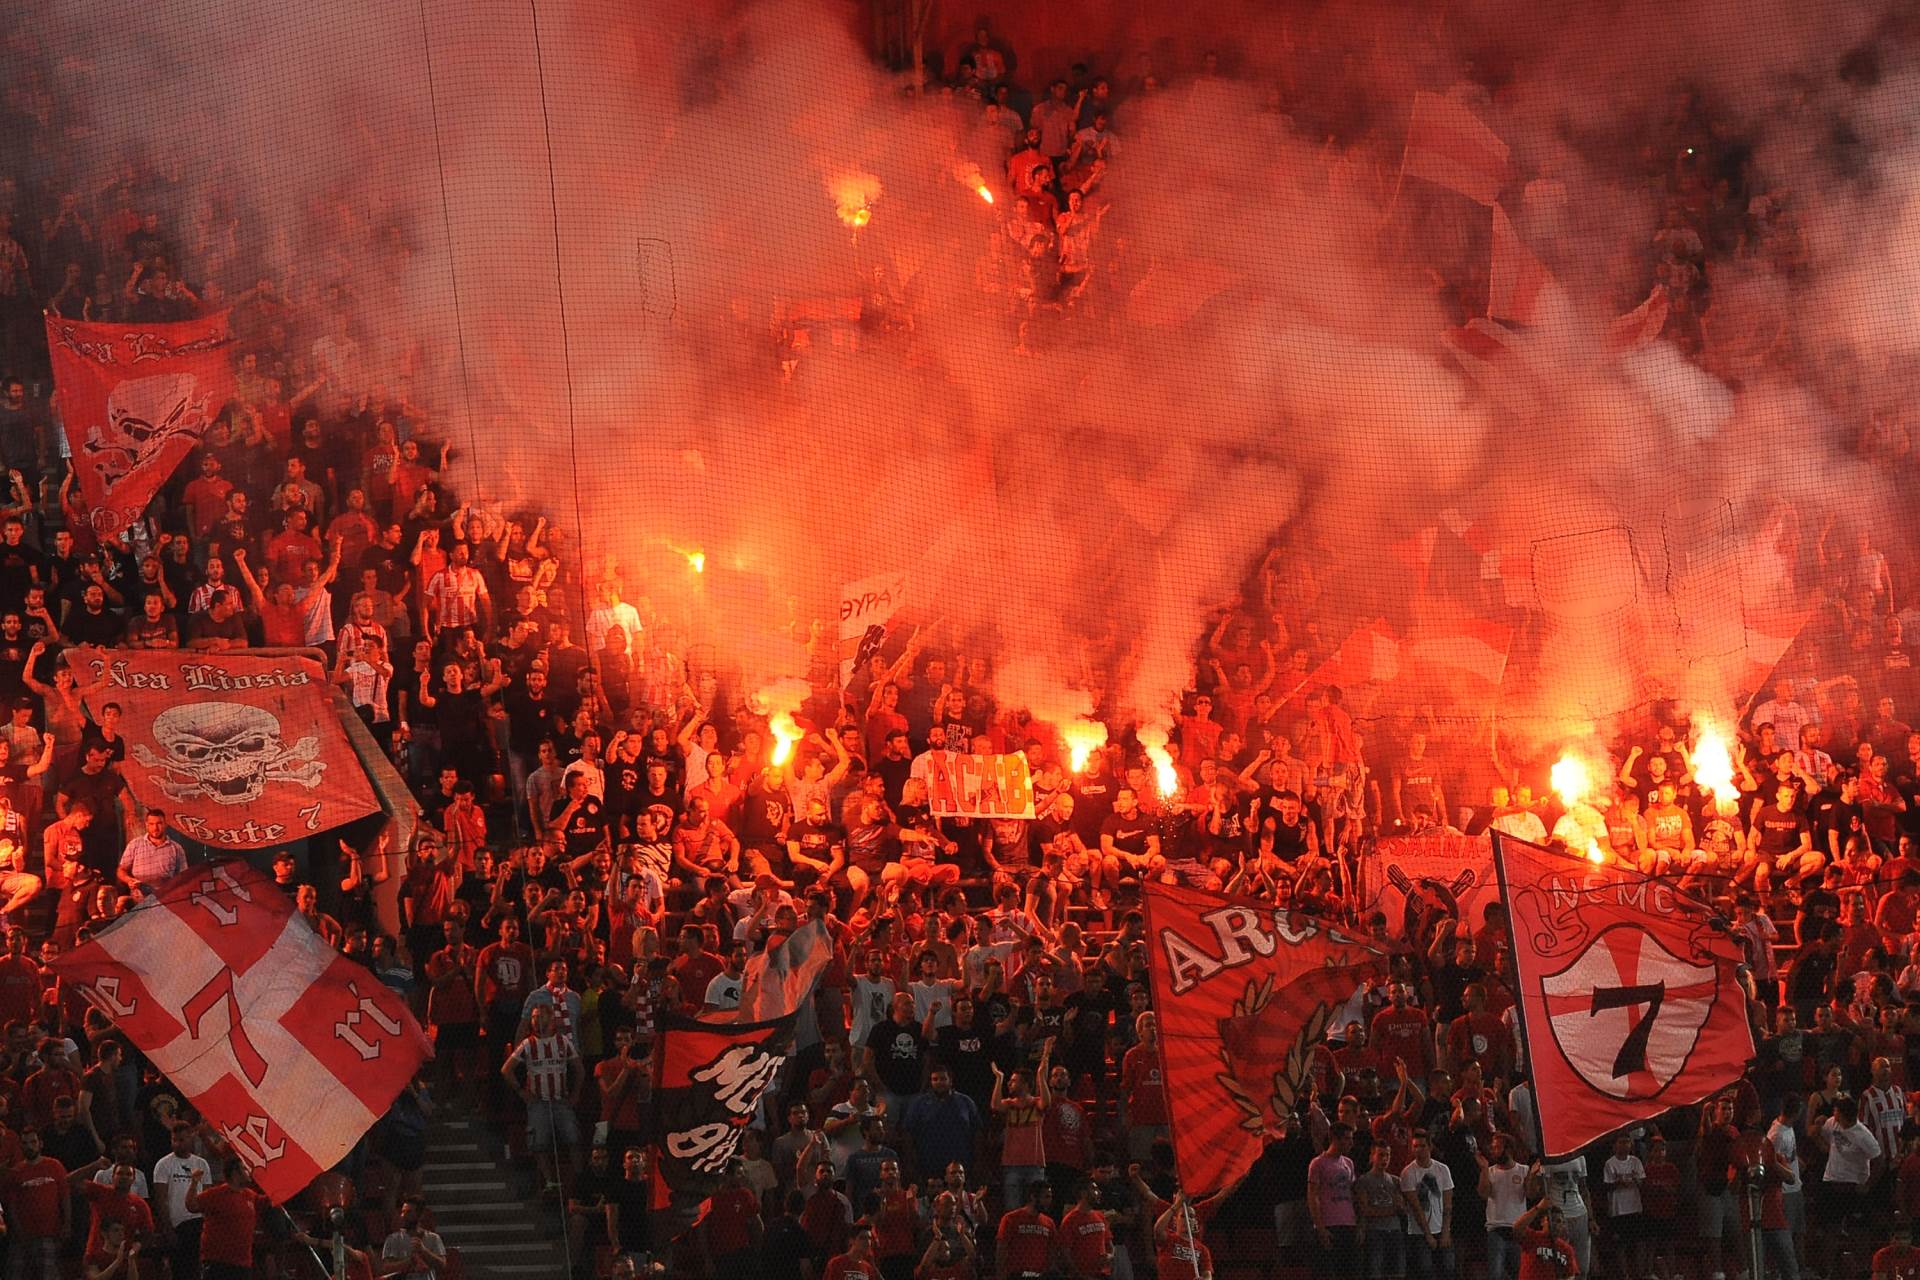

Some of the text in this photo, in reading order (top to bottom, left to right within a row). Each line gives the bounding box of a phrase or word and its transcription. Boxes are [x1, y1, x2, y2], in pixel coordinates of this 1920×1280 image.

[89, 659, 311, 692] Nea Liosia
[932, 750, 1027, 815] ACAB
[174, 802, 322, 845] Gate 7
[181, 966, 269, 1090] 7
[1589, 979, 1664, 1081] 7
